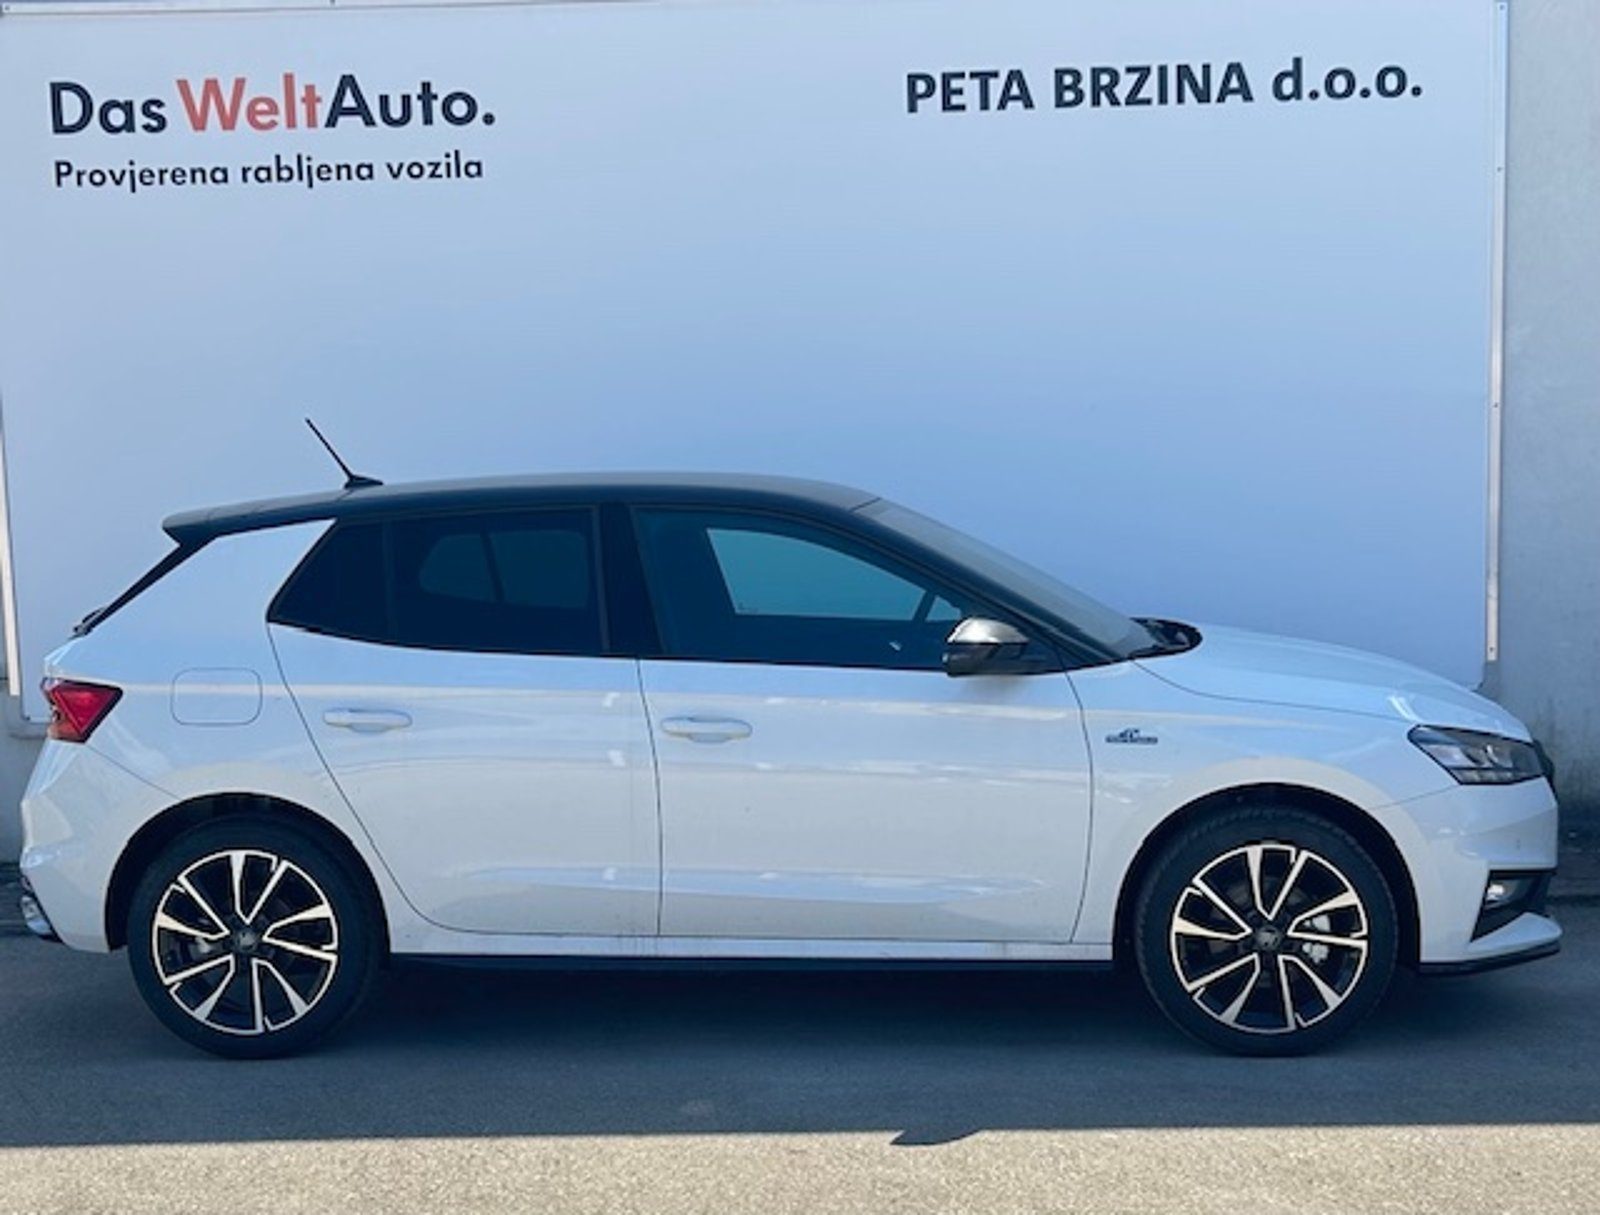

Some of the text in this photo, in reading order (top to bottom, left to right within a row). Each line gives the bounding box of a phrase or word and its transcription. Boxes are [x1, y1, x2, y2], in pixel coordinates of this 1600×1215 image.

[49, 80, 168, 135] Das
[906, 56, 1424, 115] PETA BRZINA d.o.o.
[54, 148, 484, 194] Provjerena rabljena vozila
